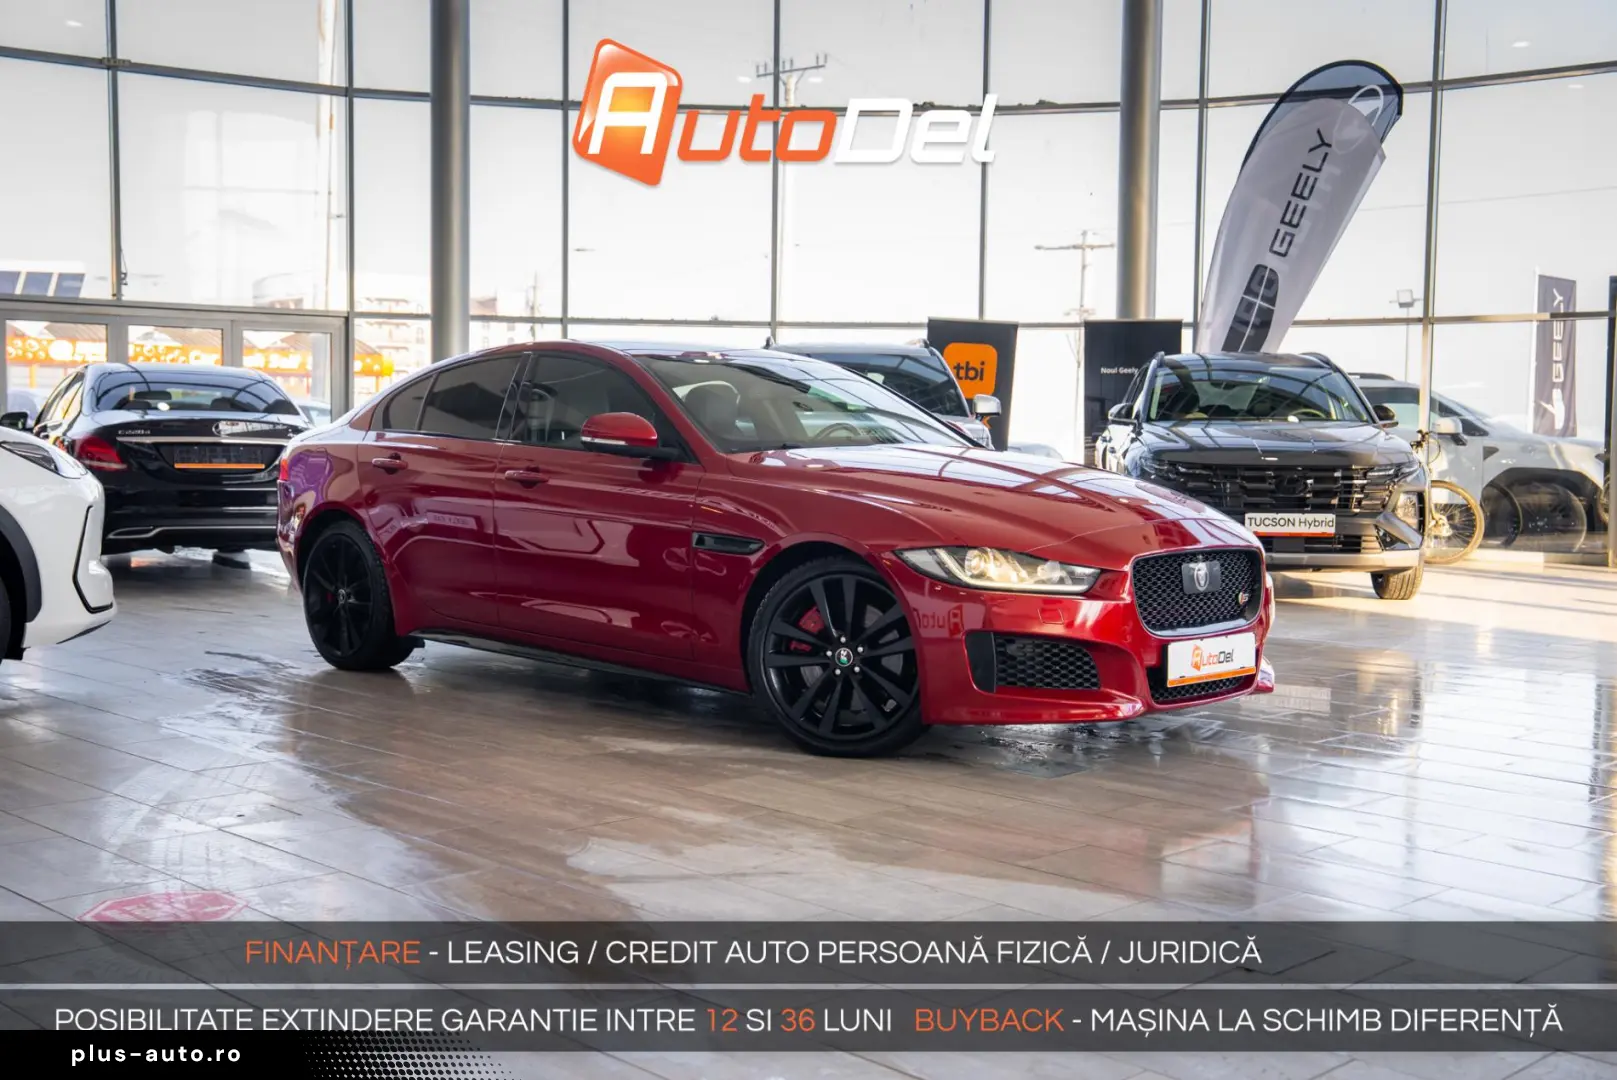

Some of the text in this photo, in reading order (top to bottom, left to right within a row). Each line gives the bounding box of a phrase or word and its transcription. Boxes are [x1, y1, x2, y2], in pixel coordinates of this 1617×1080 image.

[1268, 128, 1333, 258] GEELY
[953, 360, 986, 382] tbi
[1100, 366, 1139, 376] Noul Geely
[1247, 516, 1335, 530] TUCSON Hybrid
[1191, 647, 1235, 669] AutoDel
